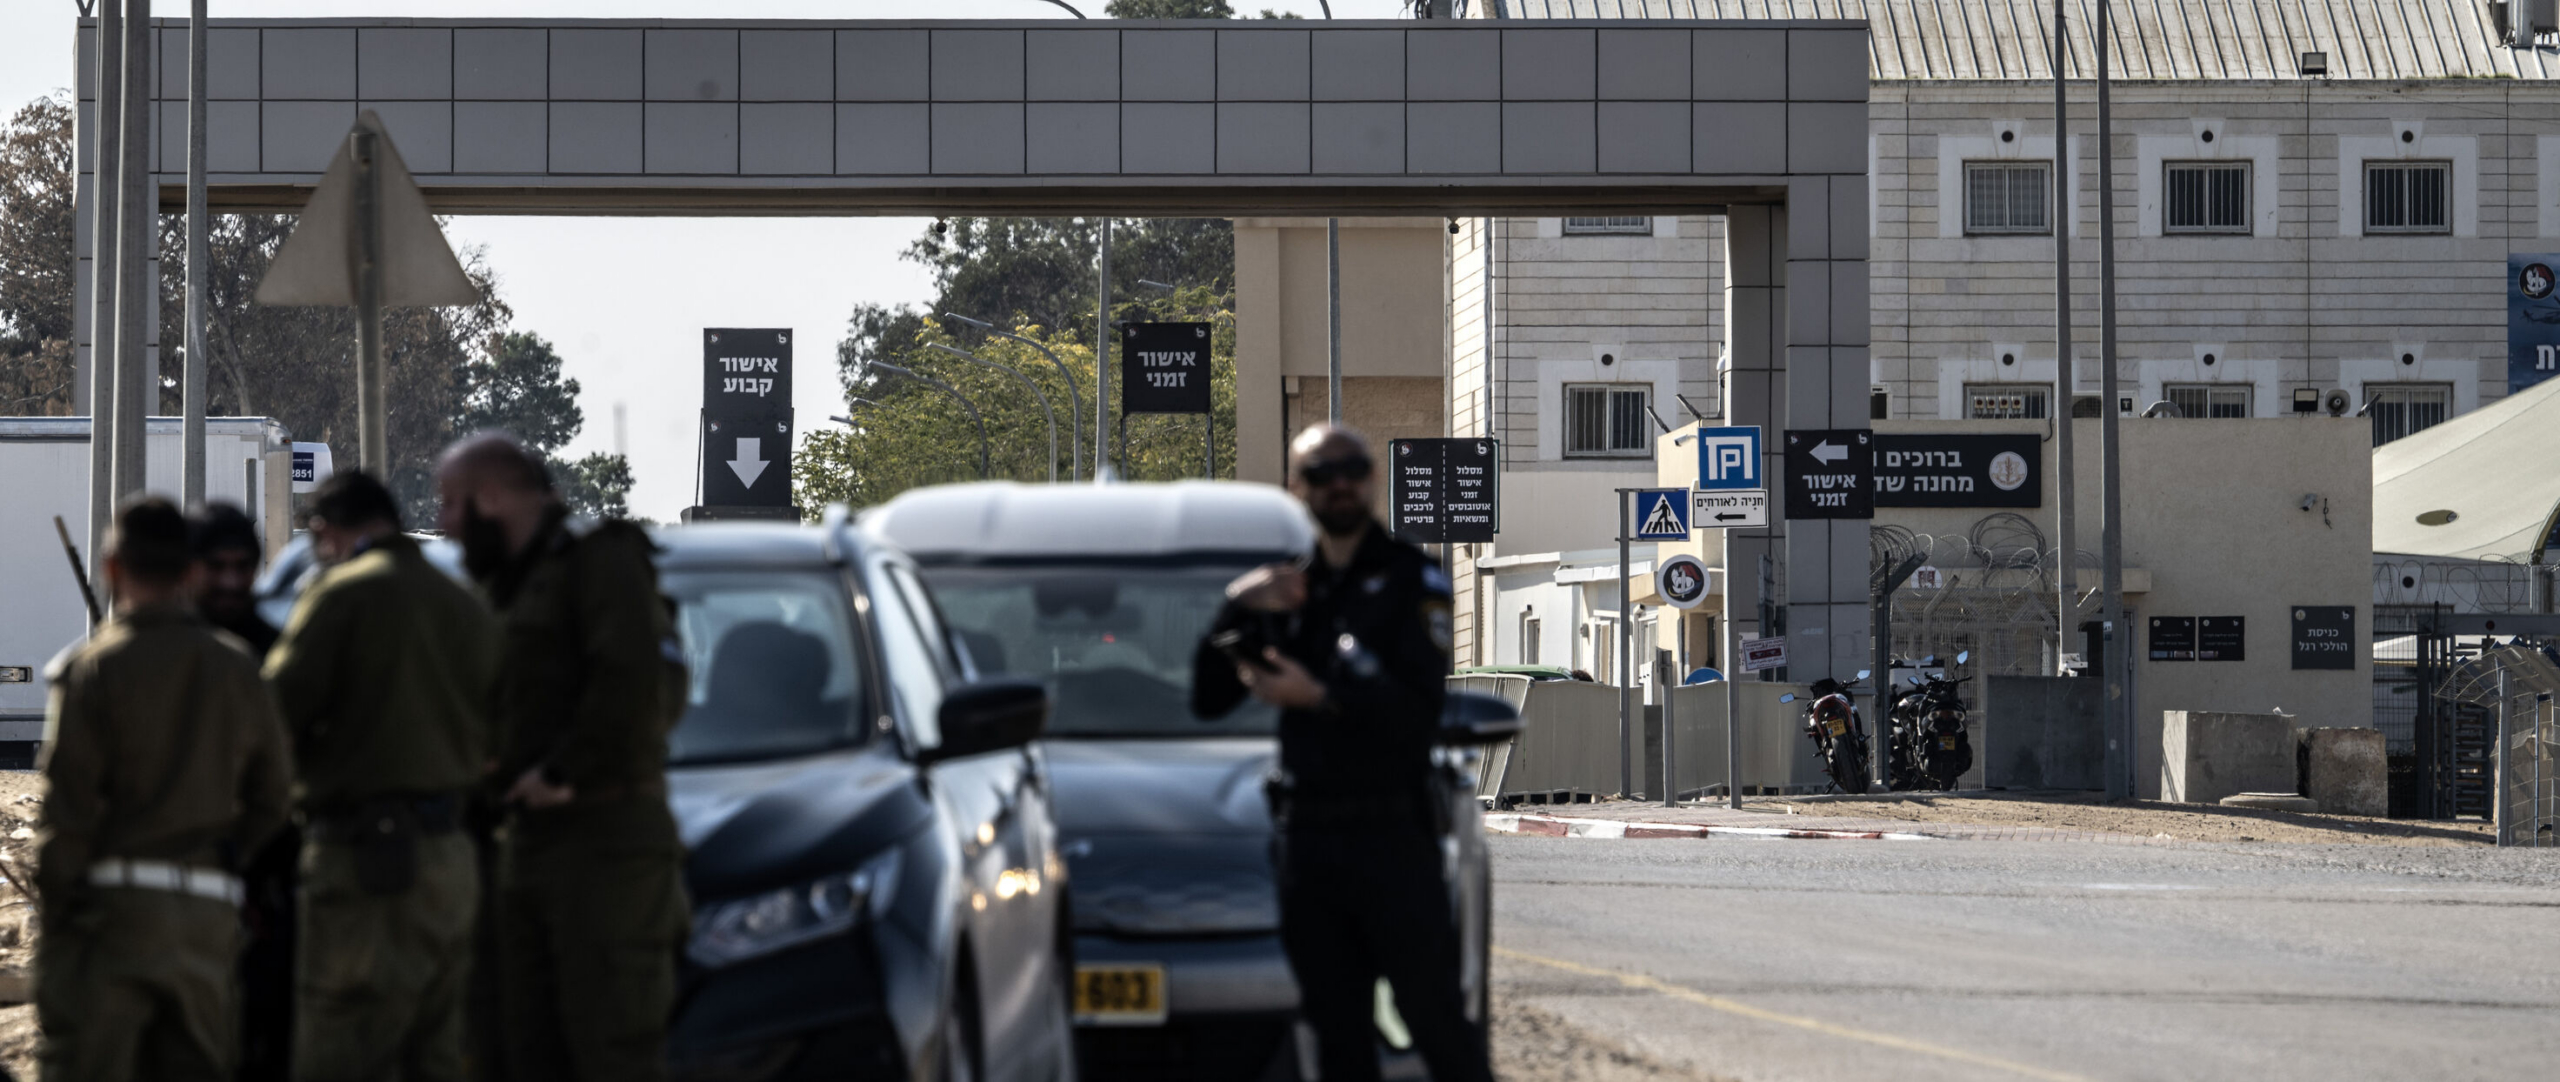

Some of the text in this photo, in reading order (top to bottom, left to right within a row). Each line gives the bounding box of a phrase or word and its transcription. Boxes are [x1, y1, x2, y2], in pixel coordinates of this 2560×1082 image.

[1137, 351, 1196, 367] אישור
[2536, 344, 2560, 370] ת
[719, 357, 778, 373] אישור
[1146, 372, 1187, 387] זמני
[723, 377, 773, 397] קבוע
[1886, 451, 1962, 467] ברוכים
[1405, 466, 1432, 475] מסלול
[1456, 466, 1483, 475] מסלול
[1406, 479, 1432, 487] אישור
[1457, 479, 1482, 487] אישור
[1802, 474, 1856, 489] אישור
[1914, 476, 1974, 492] מחנה
[1408, 492, 1429, 501] קבוע
[1461, 491, 1478, 499] זמני
[1810, 492, 1848, 507] זמני
[1403, 502, 1434, 511] לרכבים
[1696, 496, 1737, 507] לאורחים
[1448, 503, 1491, 511] אוטובוסים
[1404, 516, 1434, 524] פרטיים
[1453, 515, 1489, 523] ומשאיות
[2307, 628, 2339, 637] כניסת
[2299, 640, 2348, 651] הולכי רגל
